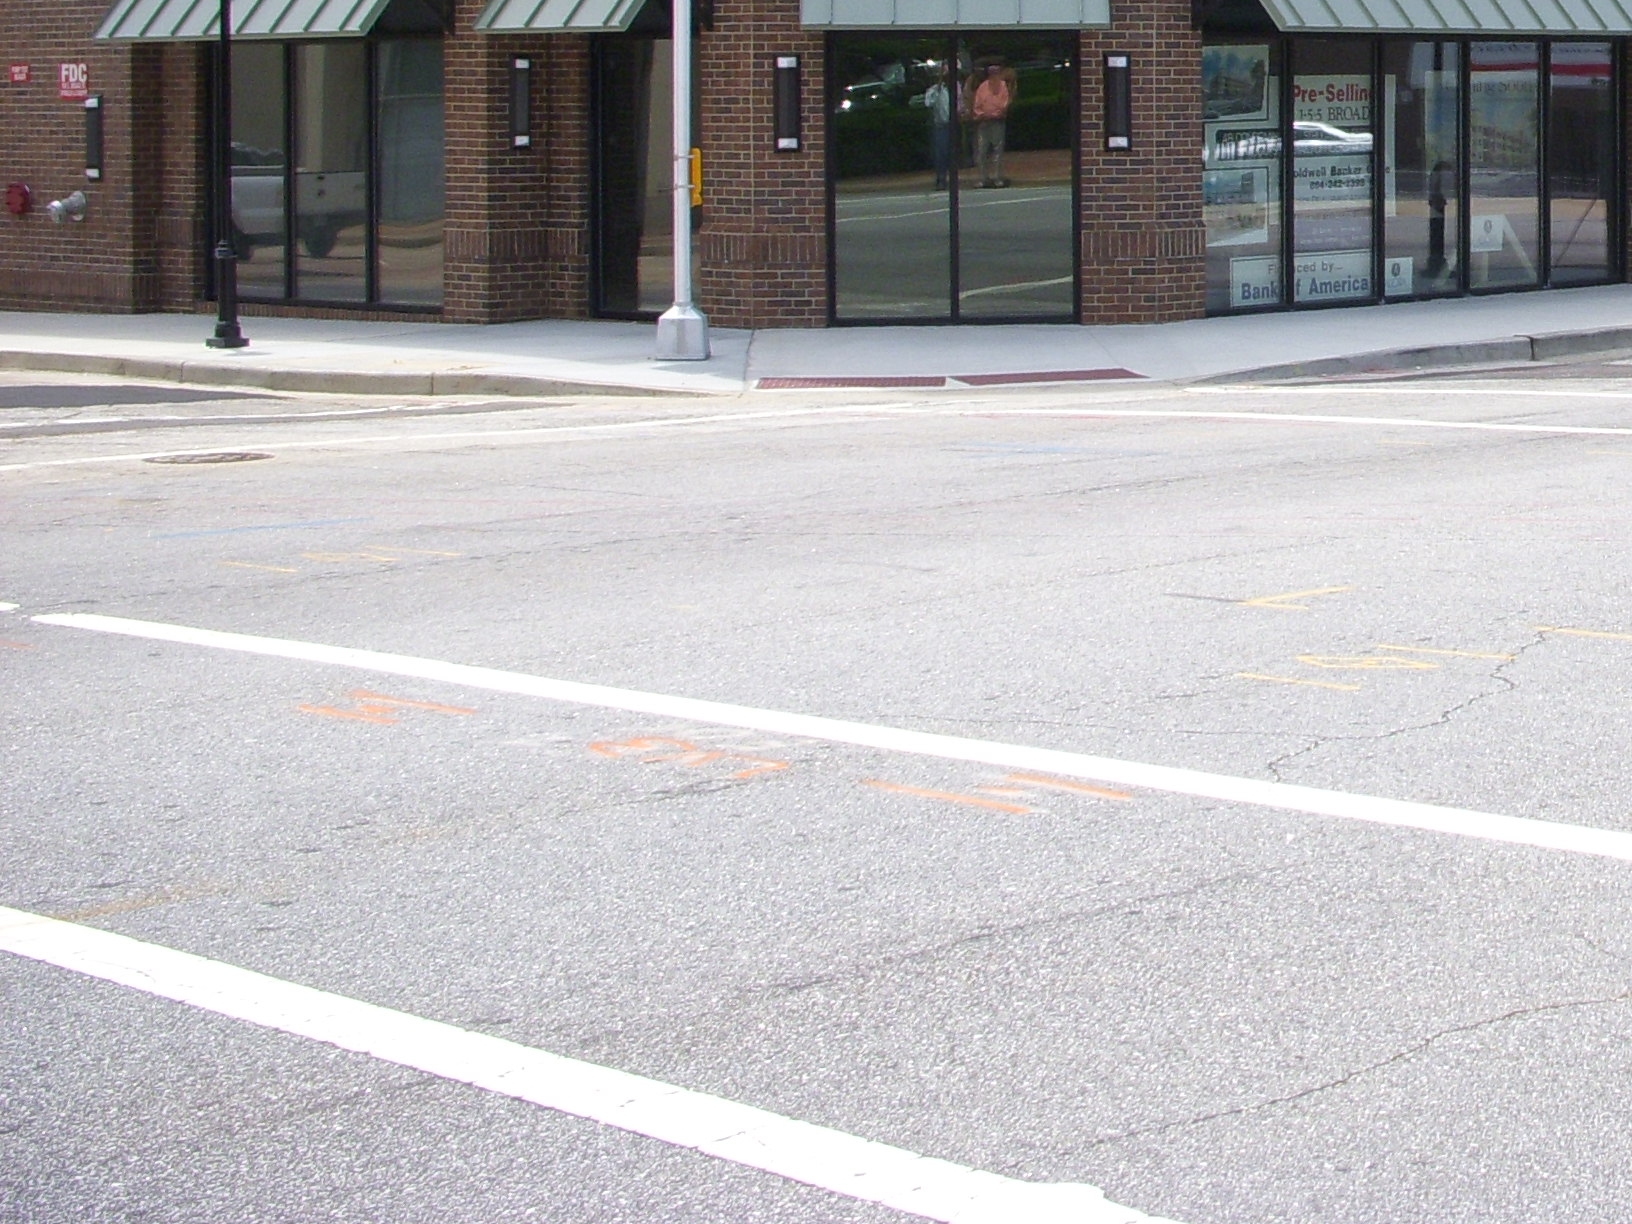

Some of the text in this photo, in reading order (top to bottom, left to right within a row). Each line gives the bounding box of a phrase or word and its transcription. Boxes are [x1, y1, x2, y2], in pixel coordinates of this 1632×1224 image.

[61, 63, 88, 83] FDC
[1293, 83, 1371, 103] Pre-Sellin
[1328, 106, 1369, 121] BROAD
[1293, 166, 1327, 178] oldwell
[1241, 281, 1280, 300] Bank
[1309, 275, 1369, 295] America
